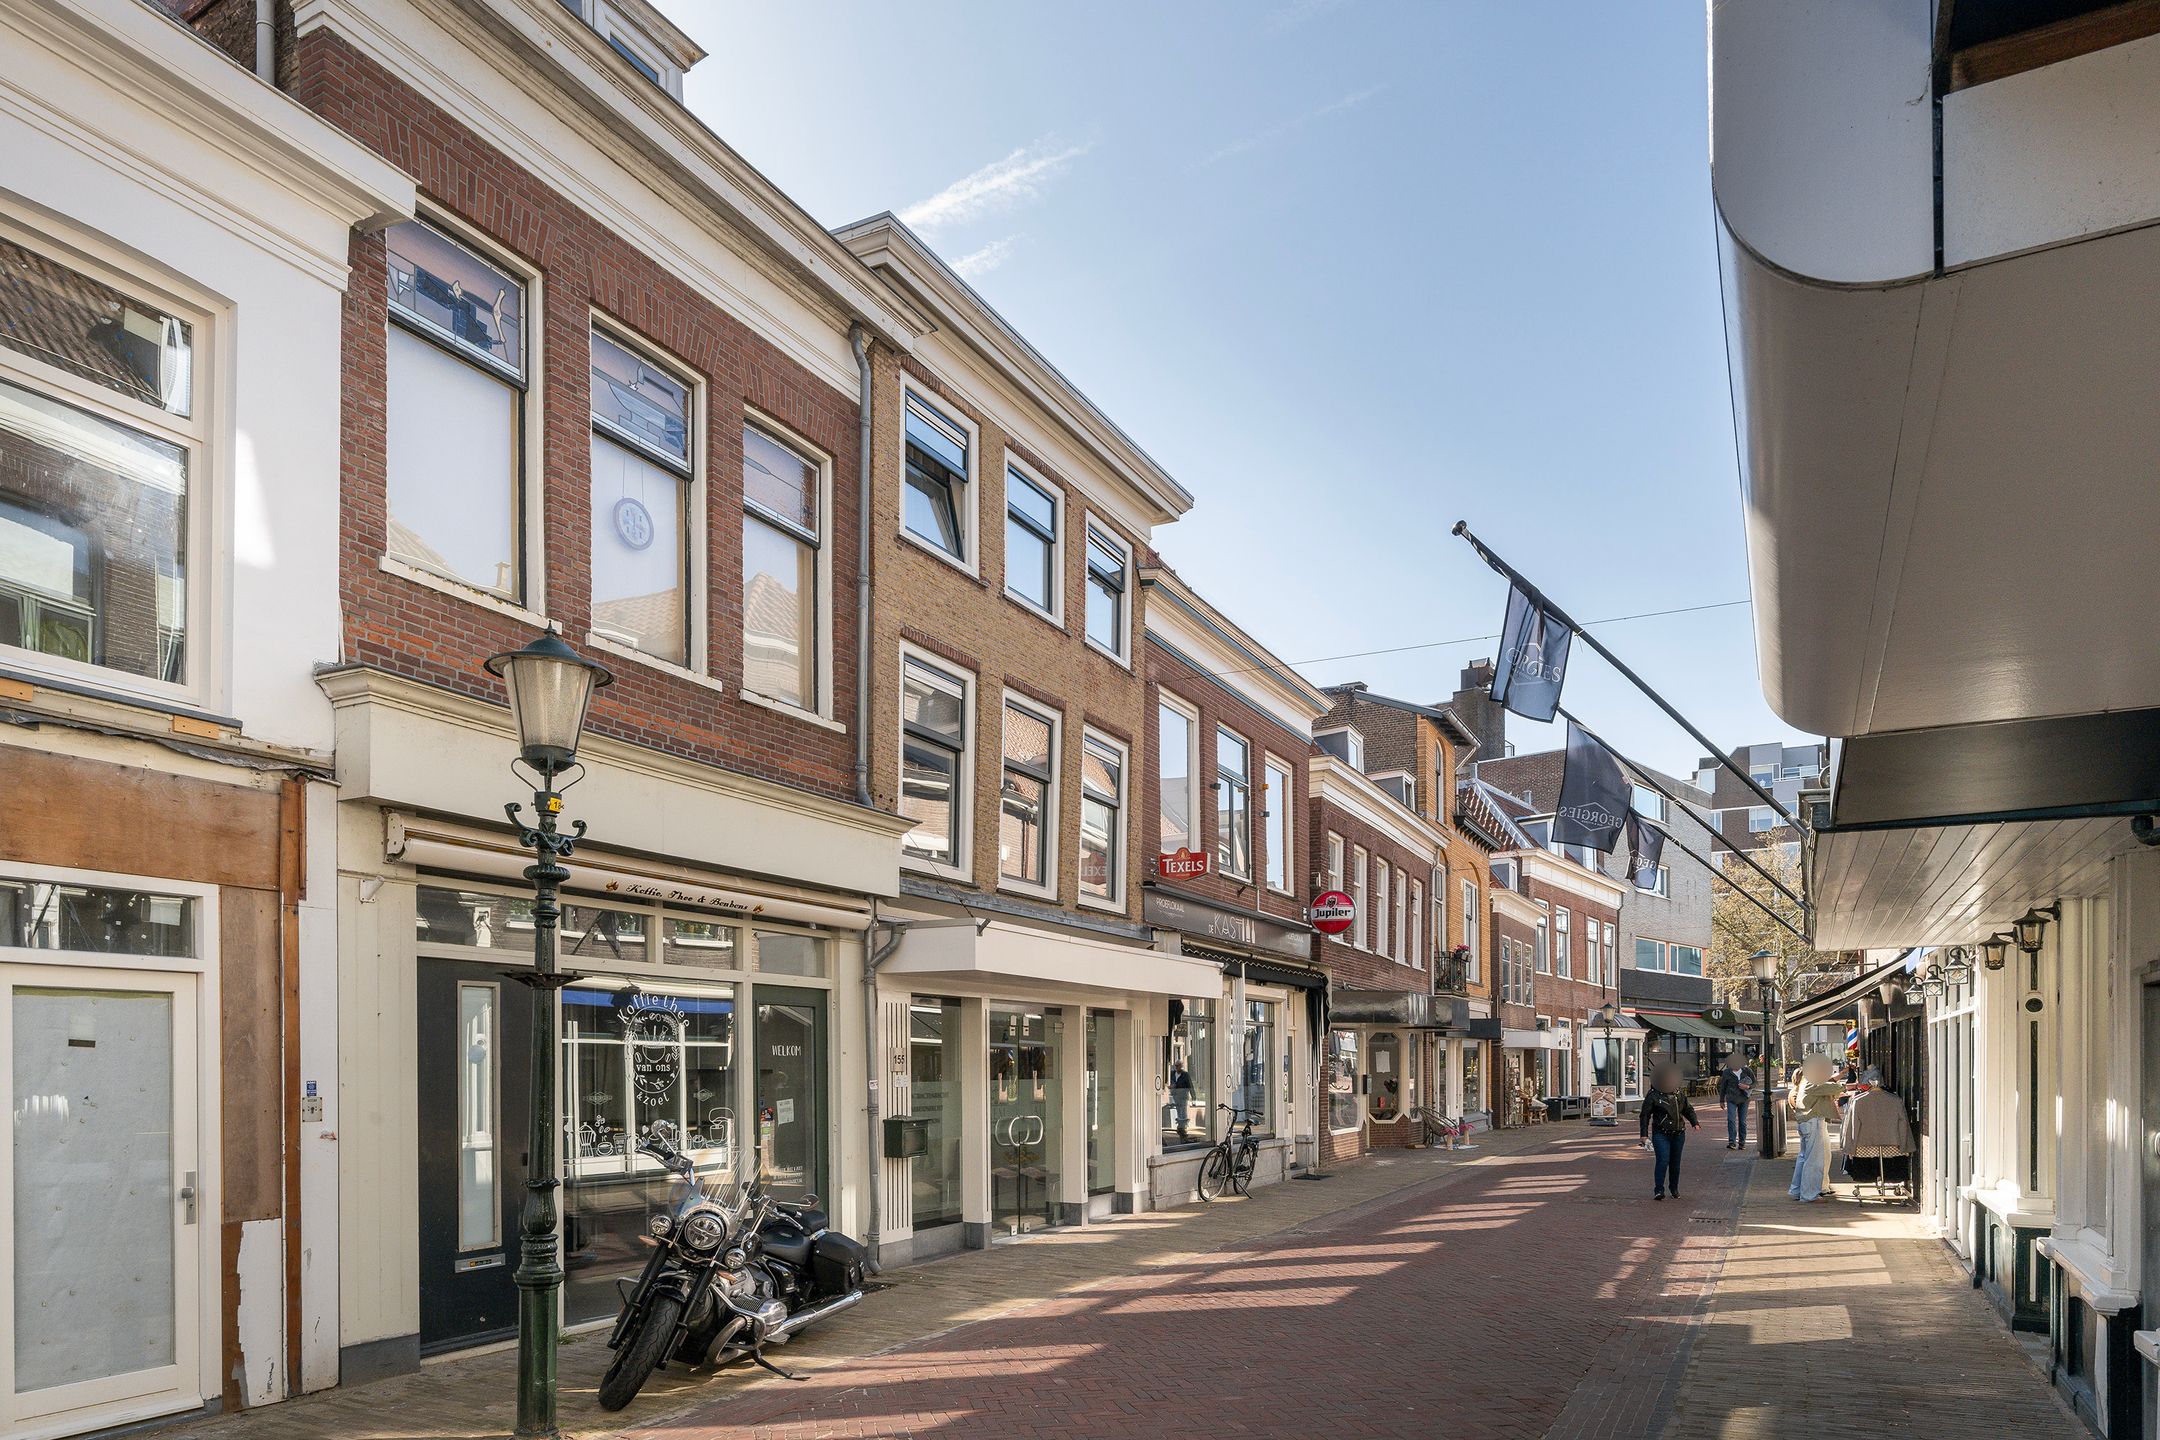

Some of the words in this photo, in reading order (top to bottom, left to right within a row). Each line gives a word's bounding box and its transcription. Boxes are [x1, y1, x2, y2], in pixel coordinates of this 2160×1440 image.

[1162, 858, 1204, 873] TEXELS
[626, 884, 663, 898] Koffie,
[667, 890, 693, 903] Thee
[709, 897, 748, 911] Bonbons
[1315, 908, 1351, 918] Jupiler
[1208, 924, 1214, 934] DE
[617, 992, 659, 1024] Koffie
[771, 1045, 801, 1056] WELKOM
[894, 1054, 905, 1065] 155
[636, 1063, 652, 1071] van
[655, 1063, 671, 1071] ons
